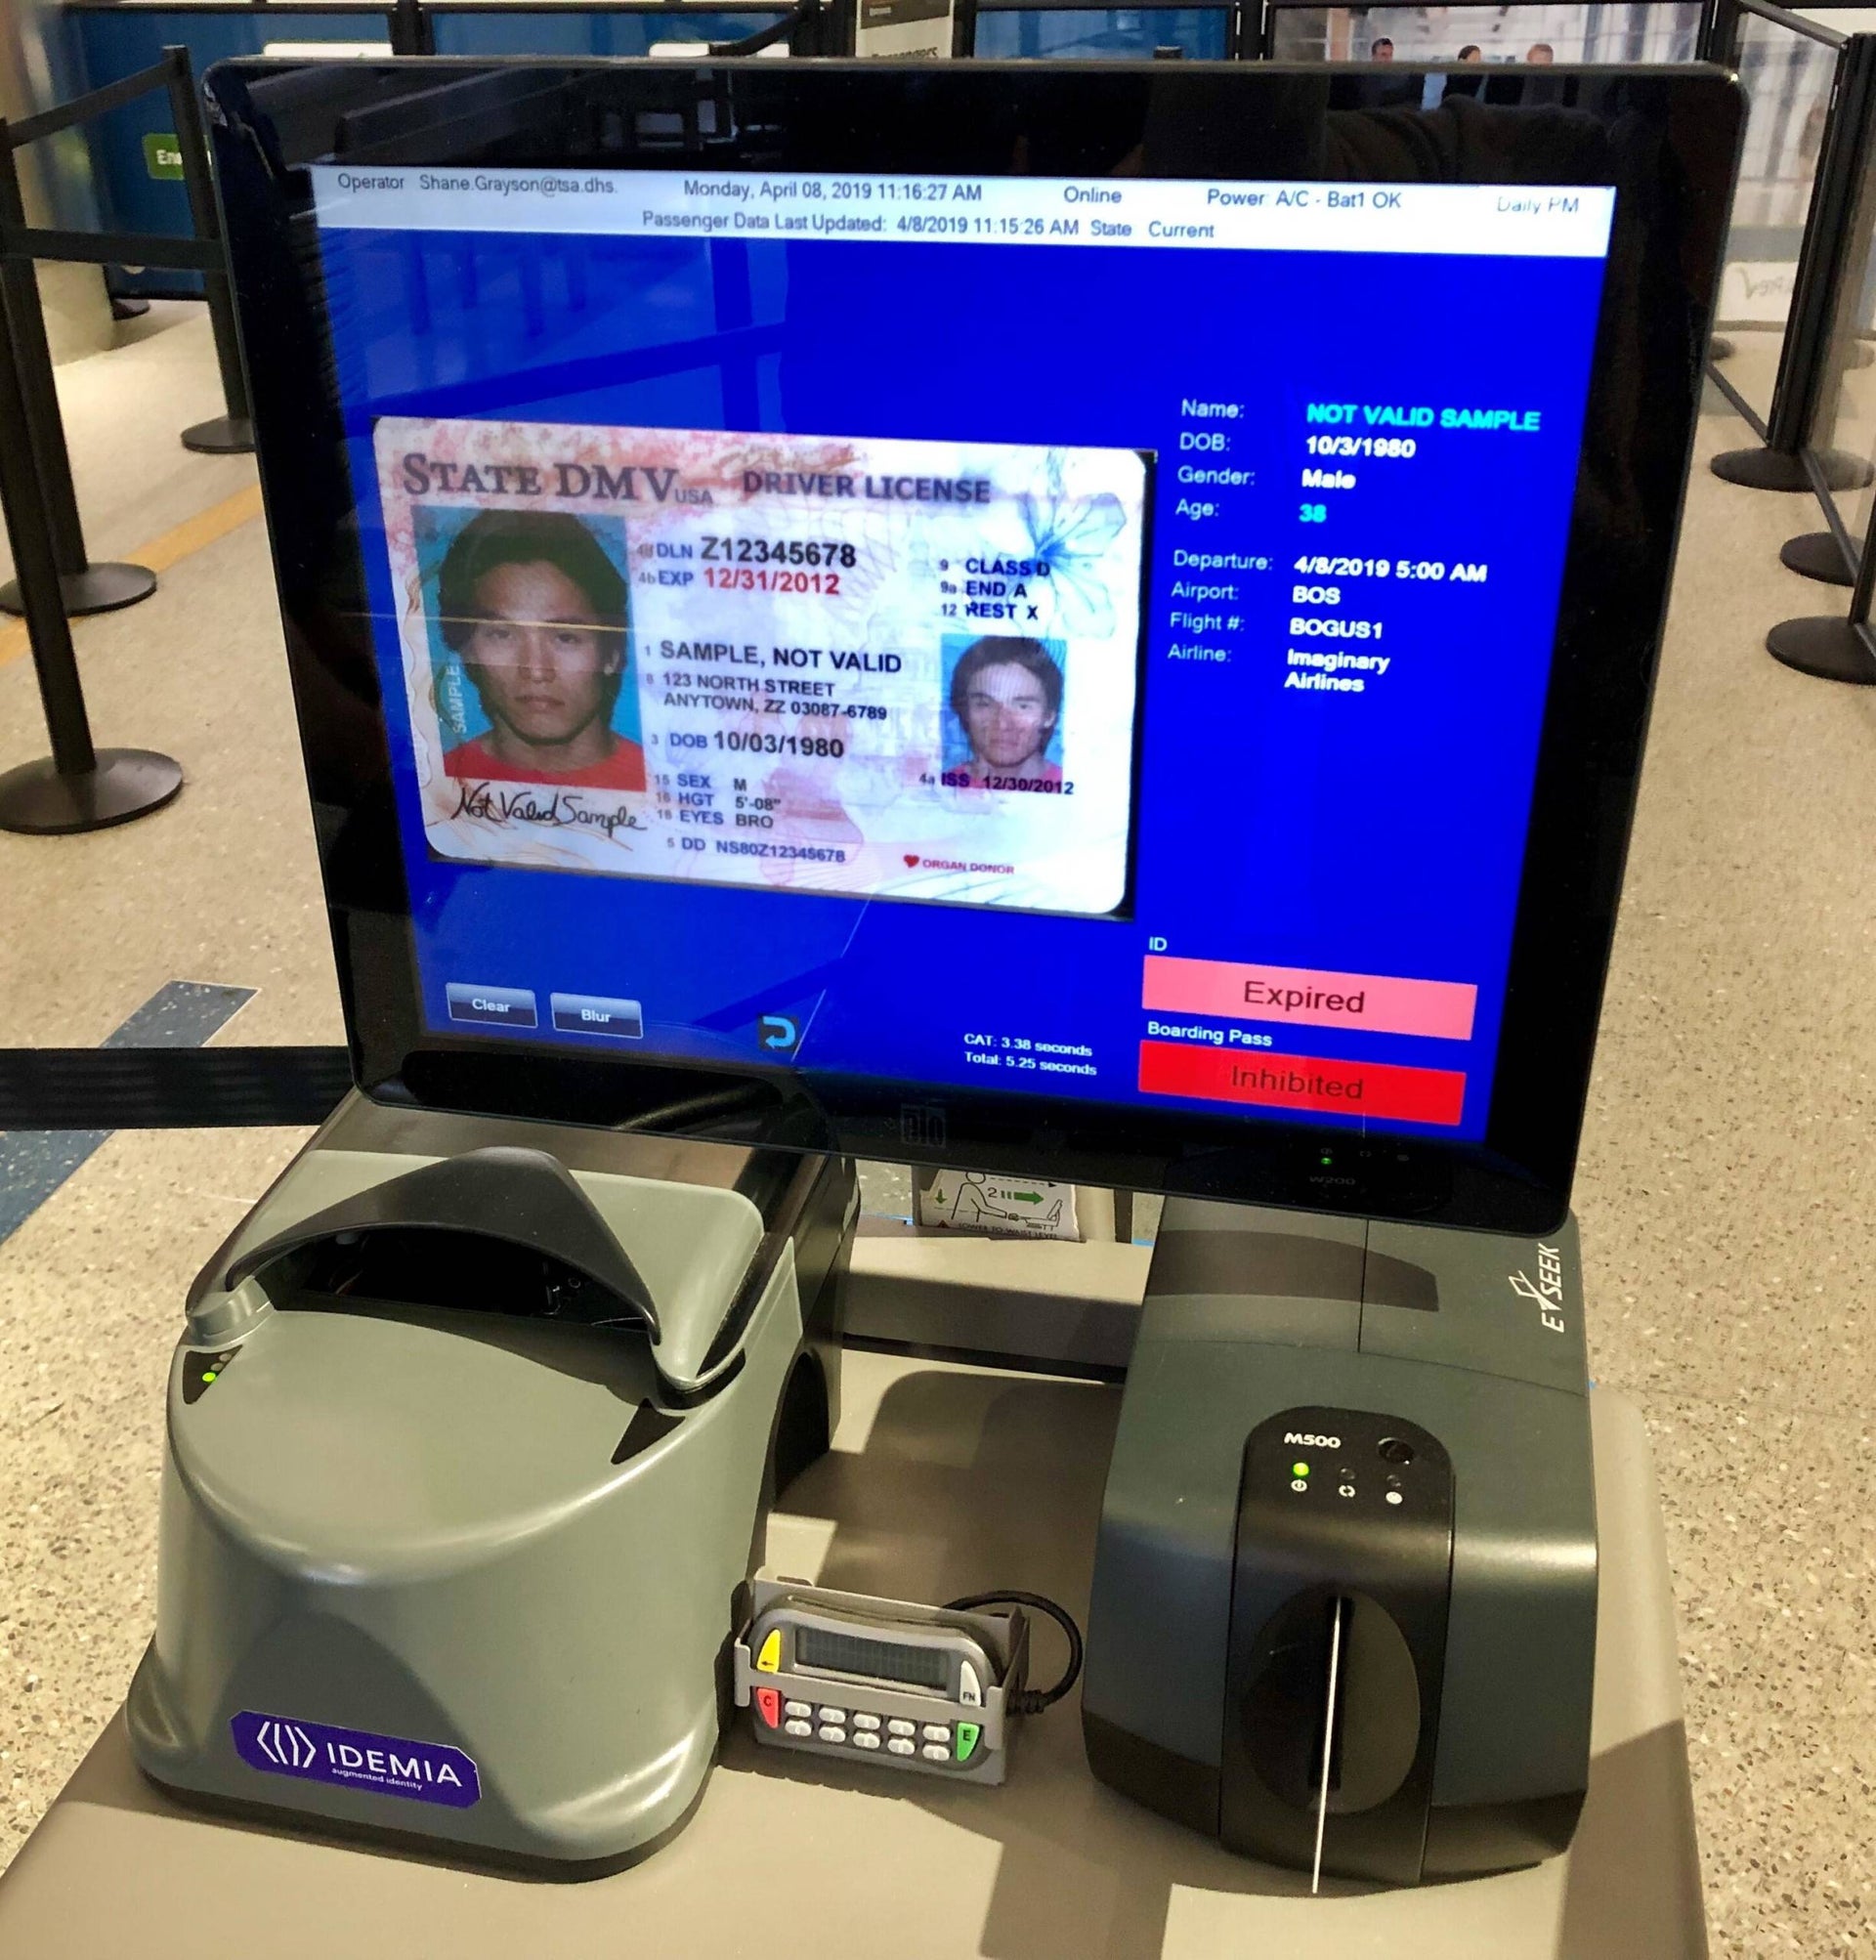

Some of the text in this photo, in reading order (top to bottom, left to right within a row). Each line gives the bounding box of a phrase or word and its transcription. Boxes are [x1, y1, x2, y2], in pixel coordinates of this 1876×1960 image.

[684, 180, 982, 202] Monday, April 08, 2019 11:16:27 AM
[1064, 186, 1123, 205] Online
[1275, 190, 1310, 208] A/C
[1327, 191, 1365, 209] Bat1
[1372, 192, 1403, 210] OK
[643, 210, 730, 234] Passenger
[734, 213, 770, 231] Data
[775, 214, 809, 232] Last
[813, 215, 887, 236] Updated:
[898, 217, 969, 234] 4/8/2019
[974, 219, 1044, 236] 11:15:26
[1050, 220, 1079, 237] AM
[1148, 221, 1215, 239] Current
[1181, 398, 1542, 432] Name: NOT VALID SAMPLE
[1179, 432, 1417, 458] DOB: 10/3/1980
[554, 463, 679, 505] DMV
[675, 489, 713, 506] USA
[743, 470, 992, 504] DRIVER LICENSE
[1177, 464, 1357, 490] Gender: Male
[1175, 498, 1327, 524] Age: 38
[657, 542, 693, 560] DLN
[700, 535, 857, 569] Z12345678
[940, 558, 1050, 576] 9 CLASS D
[1173, 549, 1489, 583] Departure: 4/8/2019 5:00 AM
[638, 566, 841, 596] 4b EXP 12/31/2012
[965, 579, 1006, 597] END
[1013, 583, 1027, 598] A
[1172, 581, 1341, 606] Airport: BOS
[941, 601, 1038, 620] 12 REST X
[1171, 612, 1221, 633] Flight
[1289, 617, 1383, 639] BOGUS1
[660, 640, 766, 668] SAMPLE,
[773, 648, 823, 668] NOT
[829, 650, 902, 673] VALID
[1168, 643, 1390, 675] Airline: Imaginary
[663, 671, 692, 688] 123
[697, 674, 759, 692] NORTH
[764, 678, 835, 698] STREET
[1284, 670, 1366, 693] Airlines
[446, 664, 468, 735] SAMPLE
[663, 692, 887, 721] ANYTOWN, ZZ 03087-6789
[669, 732, 707, 749] DOB
[713, 730, 844, 759] 10/03/1980
[677, 773, 711, 789] SEX
[733, 778, 747, 792] M
[941, 772, 970, 788] ISS
[983, 775, 1074, 795] 12/30/2012
[678, 791, 714, 807] HGT
[561, 795, 648, 838] Sample
[679, 809, 724, 826] EYES
[736, 813, 774, 830] BRO
[681, 836, 705, 852] DD
[922, 858, 1014, 874] ORGAN DONOR
[1149, 936, 1168, 952] ID
[472, 997, 511, 1013] Clear
[1244, 980, 1365, 1013] Expired
[580, 1008, 611, 1023] Blur
[963, 1033, 1092, 1057] CAT: 3.38 seconds
[1147, 1021, 1273, 1047] Boarding Pass
[964, 1051, 1097, 1076] Total: 5.25 seconds
[1231, 1064, 1364, 1099] Inhibited
[987, 1186, 998, 1199] 2
[1284, 1430, 1342, 1450] M500
[763, 1695, 771, 1707] C
[962, 1691, 975, 1702] FN
[962, 1729, 971, 1741] E
[327, 1742, 463, 1787] IDEMIA
[331, 1768, 423, 1792] augmented identity
